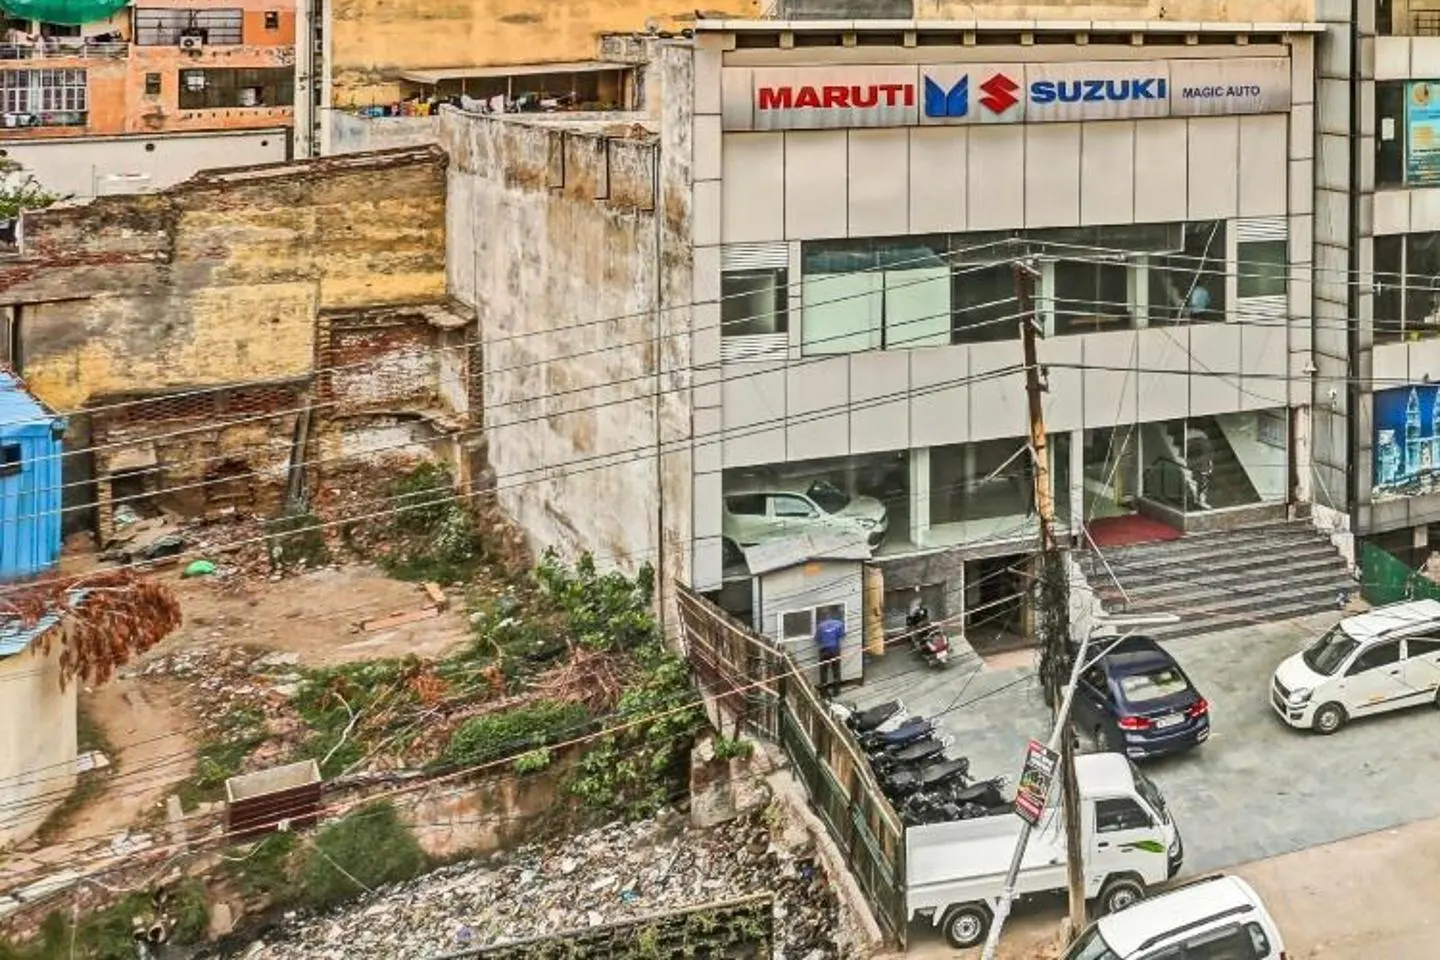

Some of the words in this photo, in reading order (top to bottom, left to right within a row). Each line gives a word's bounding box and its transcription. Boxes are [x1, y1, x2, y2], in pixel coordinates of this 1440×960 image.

[759, 84, 914, 110] MARUTI
[1030, 78, 1166, 103] SUZUKI
[1182, 86, 1224, 99] MAGIC
[1226, 85, 1261, 97] AUTO
